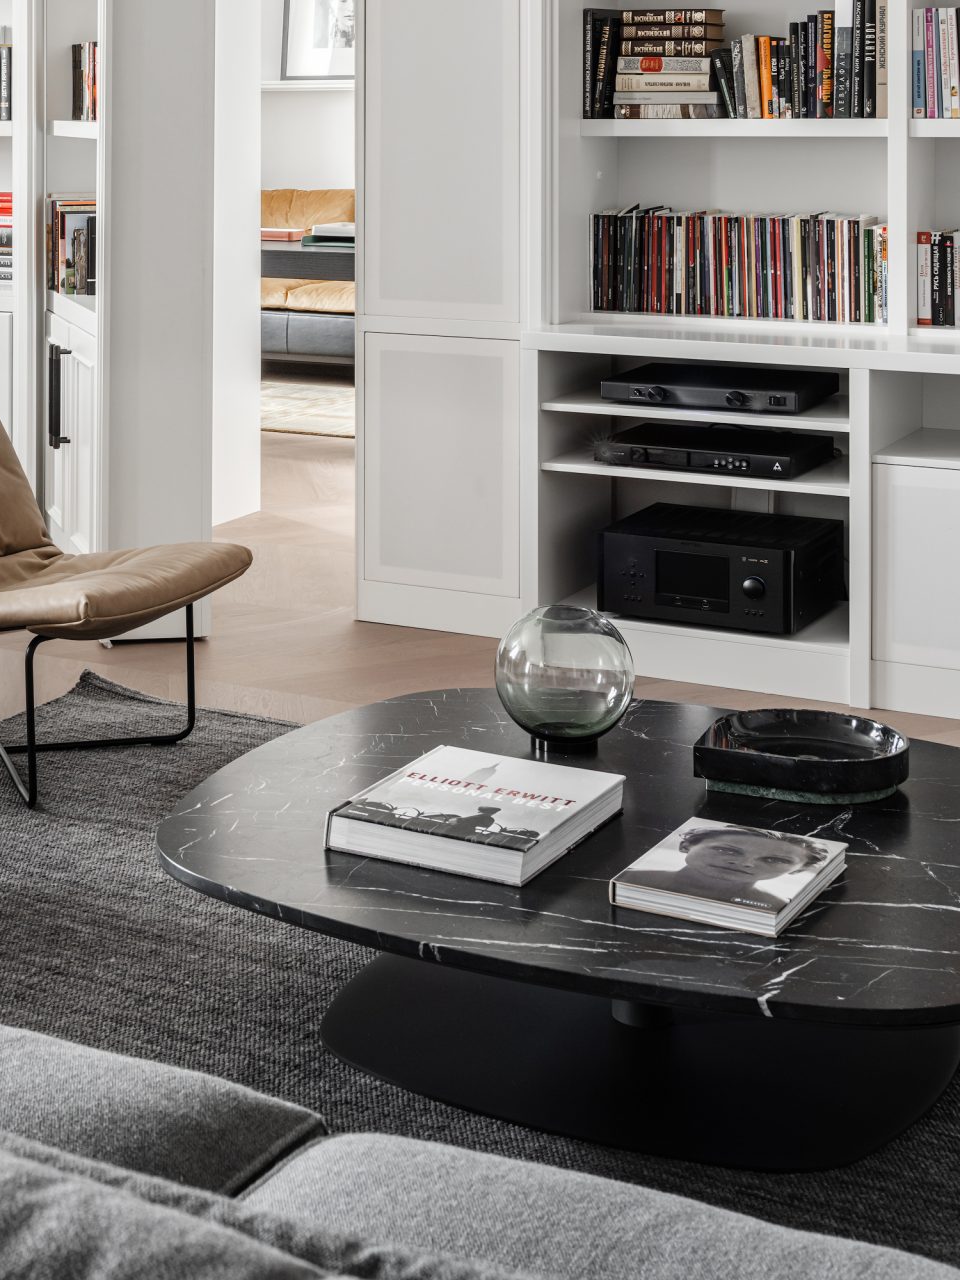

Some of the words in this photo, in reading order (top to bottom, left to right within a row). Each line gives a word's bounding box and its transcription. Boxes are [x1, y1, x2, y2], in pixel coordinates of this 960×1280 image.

[601, 25, 610, 40] ИГРА
[865, 22, 875, 61] PLAYBOY
[597, 44, 607, 79] ЛЮЦИФЕРА
[822, 14, 832, 103] БЛАГОВОЛИЛЬНИЦЫ
[878, 35, 886, 69] ЖЕНСКИЙ
[399, 778, 504, 802] PERSONAL
[511, 798, 571, 812] BEST
[407, 772, 488, 791] ELLIOTT
[493, 787, 577, 806] ERWITT
